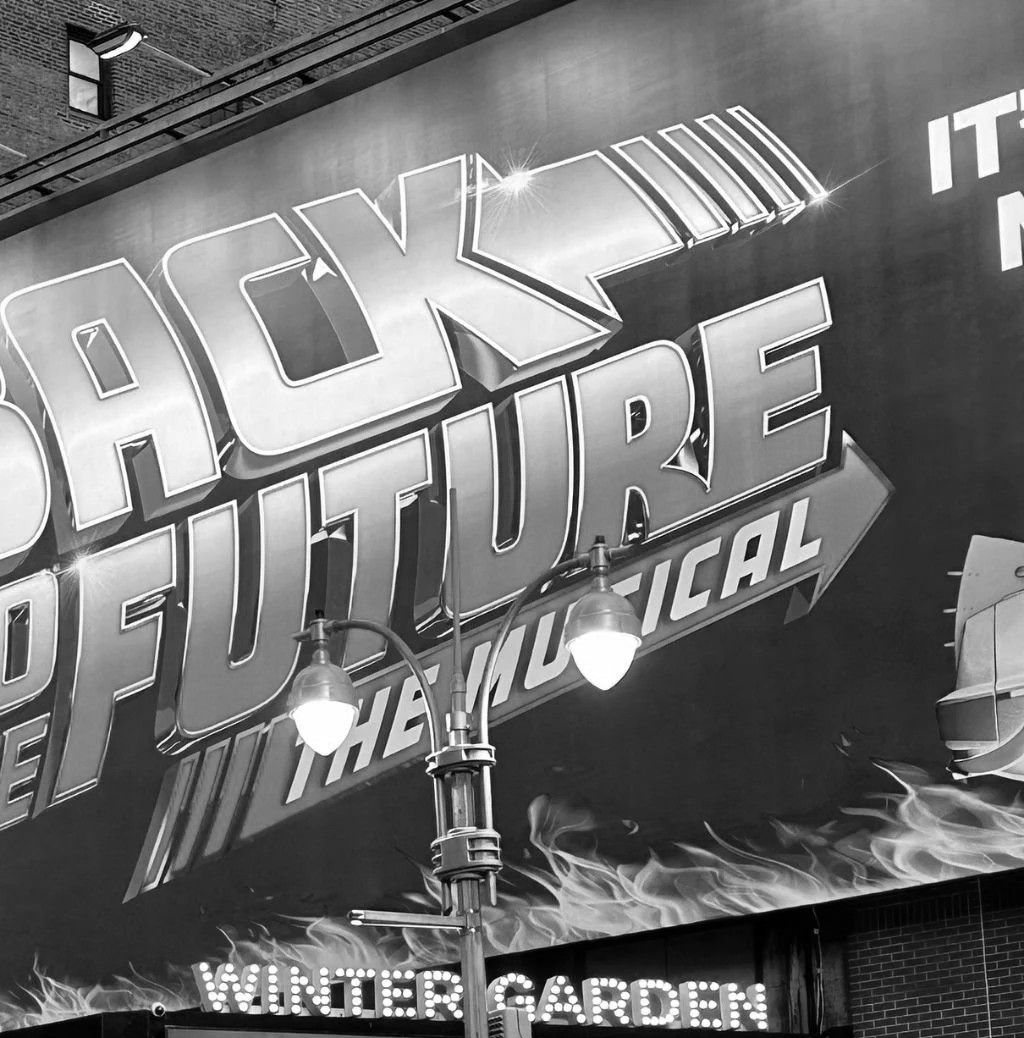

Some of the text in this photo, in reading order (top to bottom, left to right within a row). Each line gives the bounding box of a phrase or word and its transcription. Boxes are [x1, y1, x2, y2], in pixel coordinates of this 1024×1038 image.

[928, 88, 1024, 195] IT
[54, 276, 834, 808] FUTURE
[465, 498, 822, 715] MUICAL
[193, 961, 769, 1031] WINTER GARDEN
